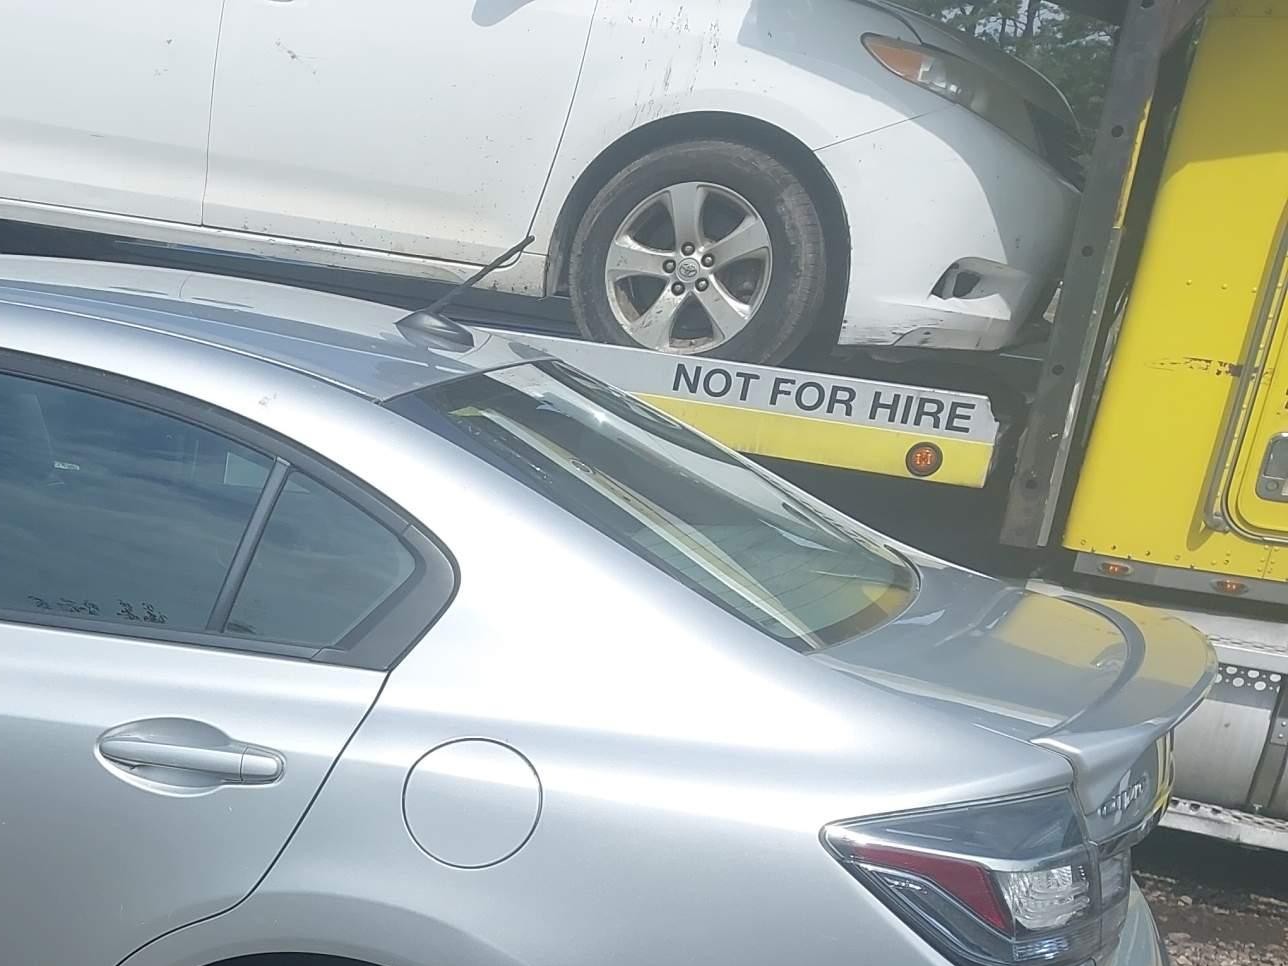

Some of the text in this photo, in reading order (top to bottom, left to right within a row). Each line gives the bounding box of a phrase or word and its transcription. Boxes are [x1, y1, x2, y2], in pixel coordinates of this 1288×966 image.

[672, 362, 976, 433] NOT FOR HIRE
